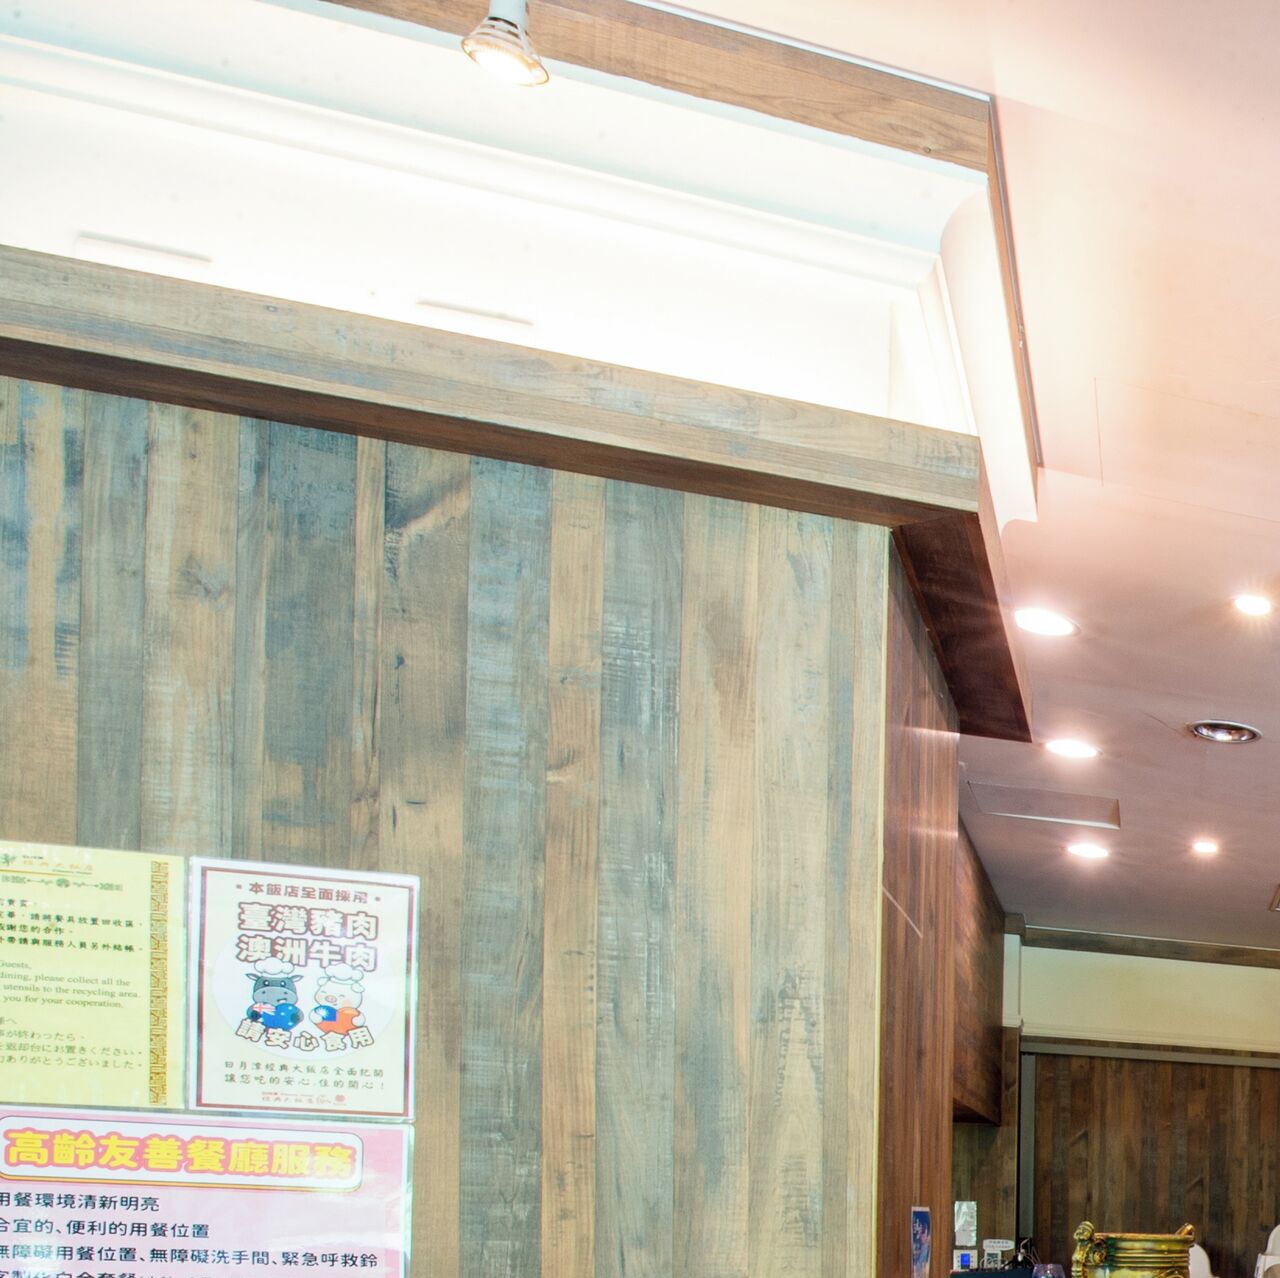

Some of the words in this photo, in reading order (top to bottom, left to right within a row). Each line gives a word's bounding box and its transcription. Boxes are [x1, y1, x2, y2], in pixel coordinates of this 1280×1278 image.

[249, 882, 368, 904] 本飯店全面採用
[238, 901, 379, 940] 臺灣豬肉
[236, 934, 378, 972] 澳洲牛肉
[235, 1018, 375, 1052] 請安心食用
[5, 1129, 357, 1180] 高齡友善餐廳服務
